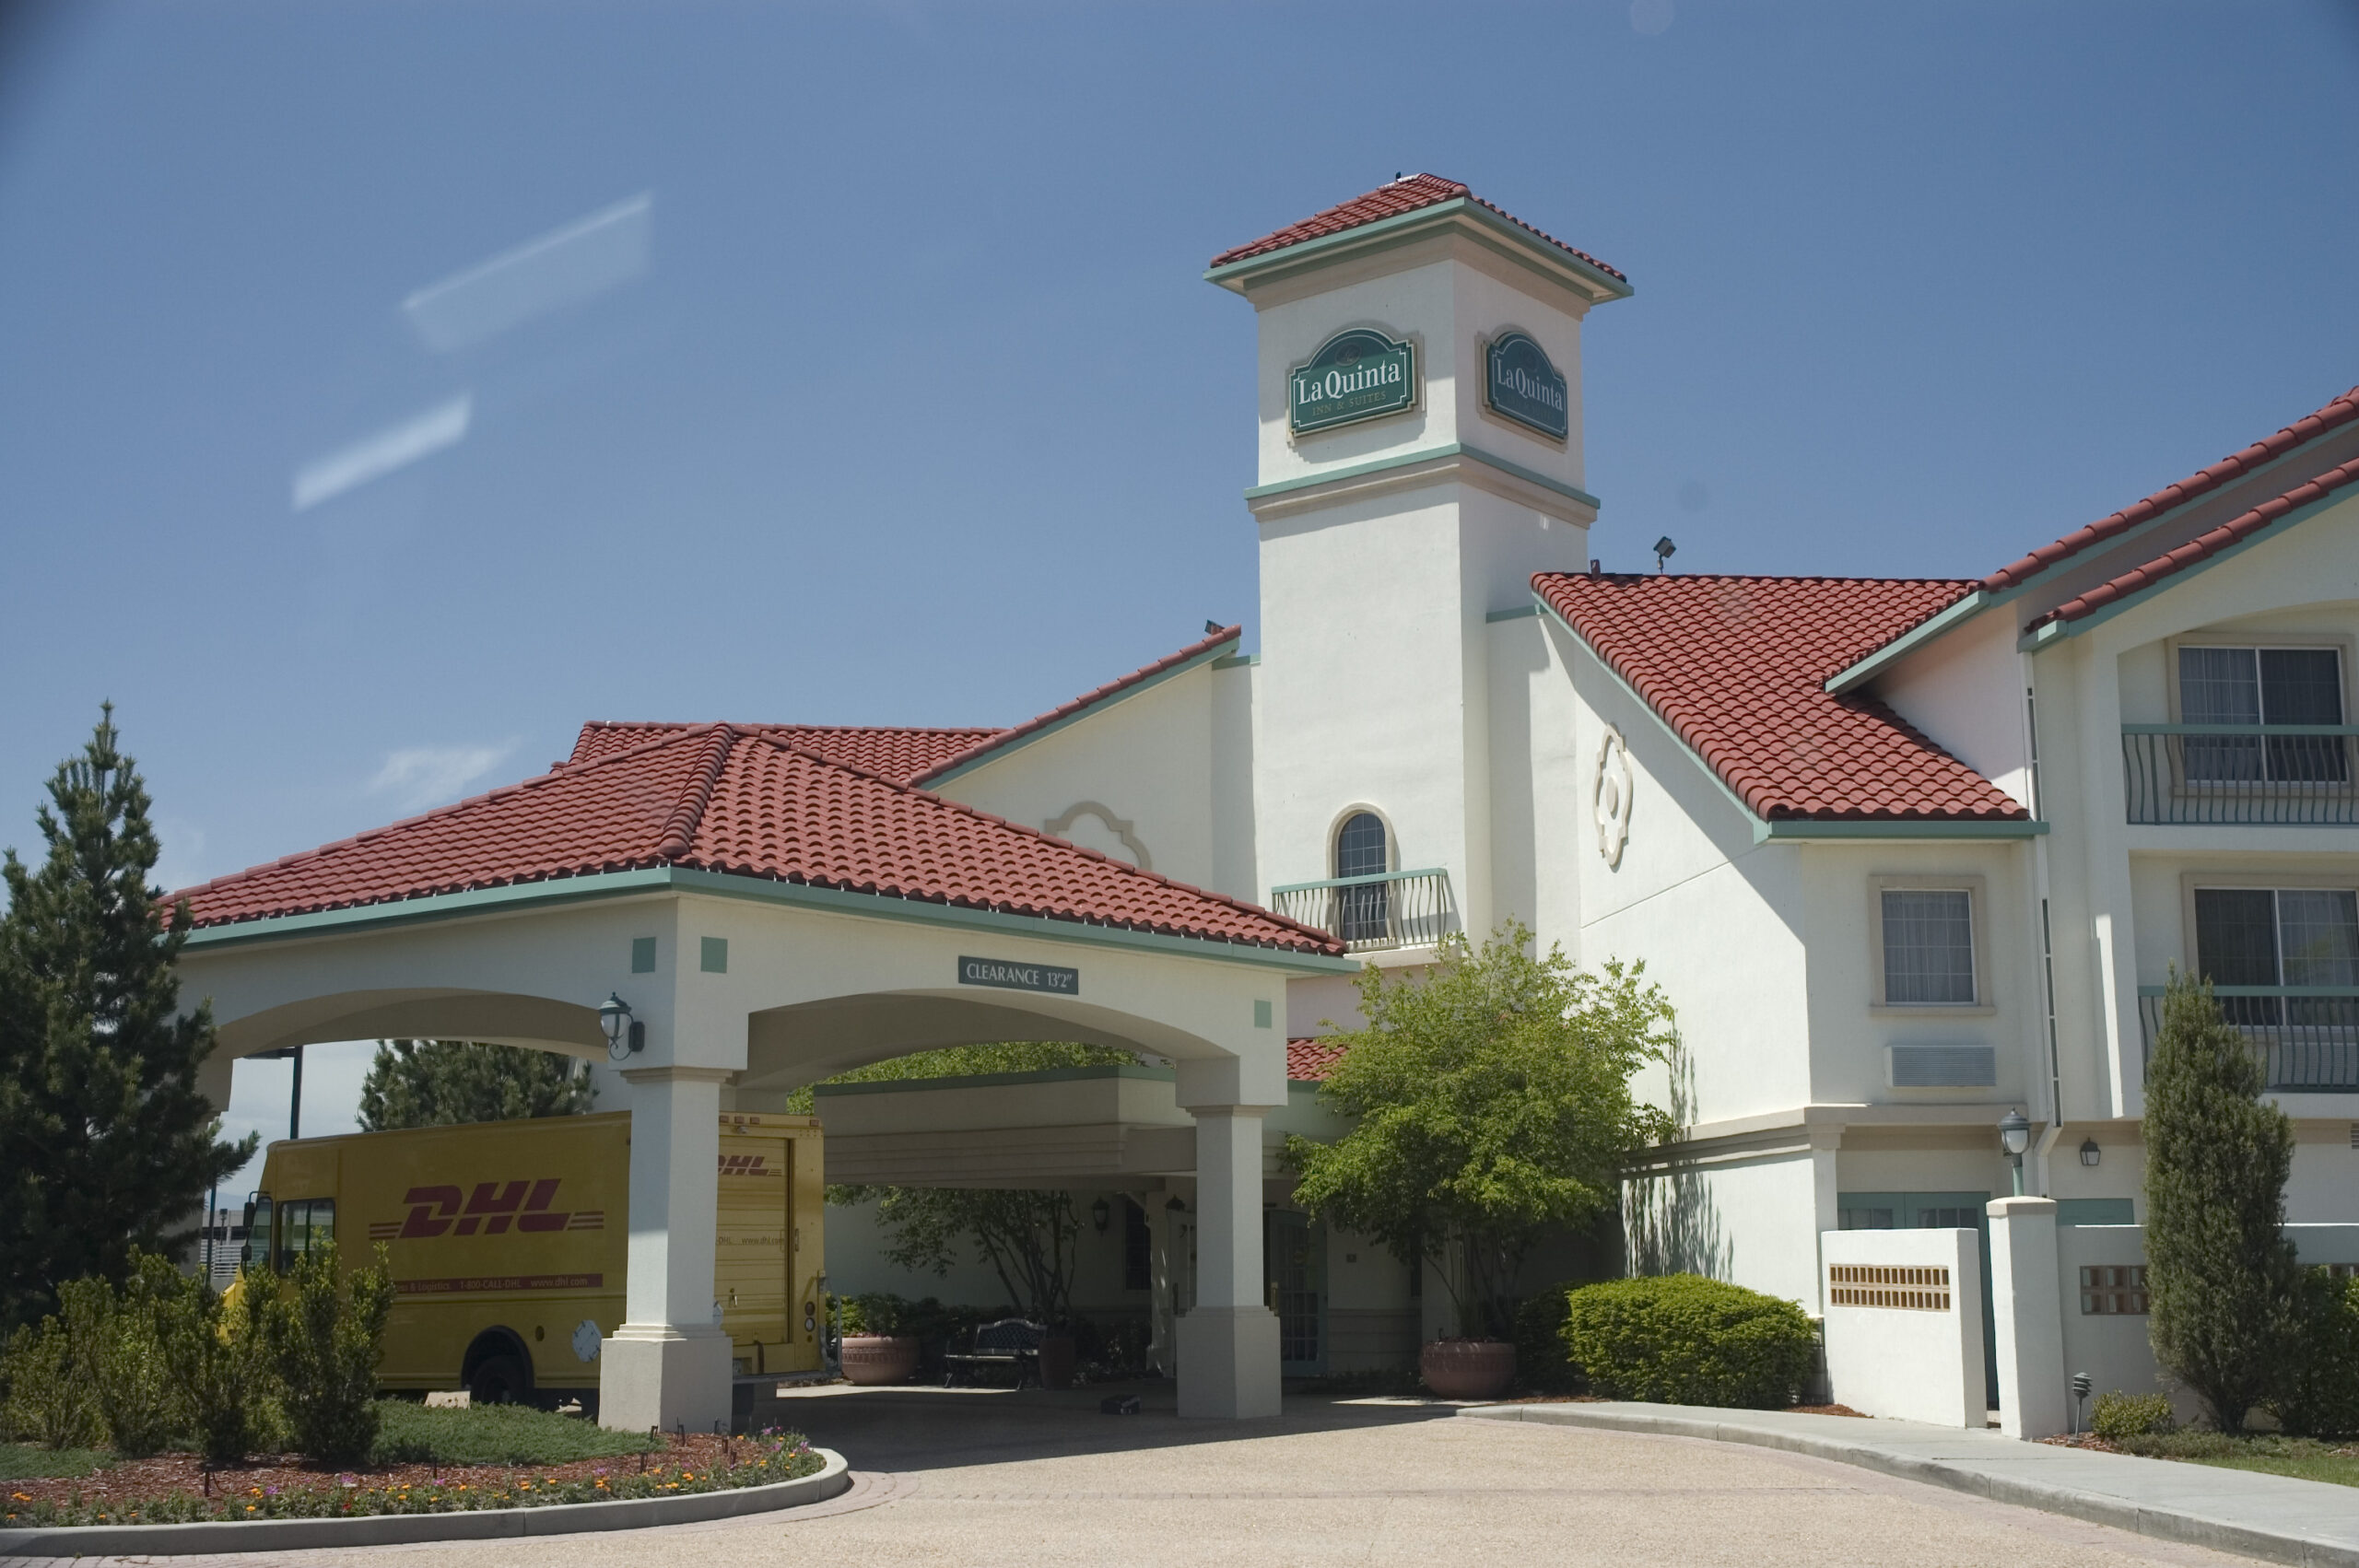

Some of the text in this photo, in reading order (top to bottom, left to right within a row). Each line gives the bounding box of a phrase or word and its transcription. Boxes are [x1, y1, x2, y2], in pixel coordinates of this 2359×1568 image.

[1312, 391, 1387, 416] INN & SUITES
[967, 963, 1039, 985] CLEARANCE
[399, 1178, 571, 1239] DHL
